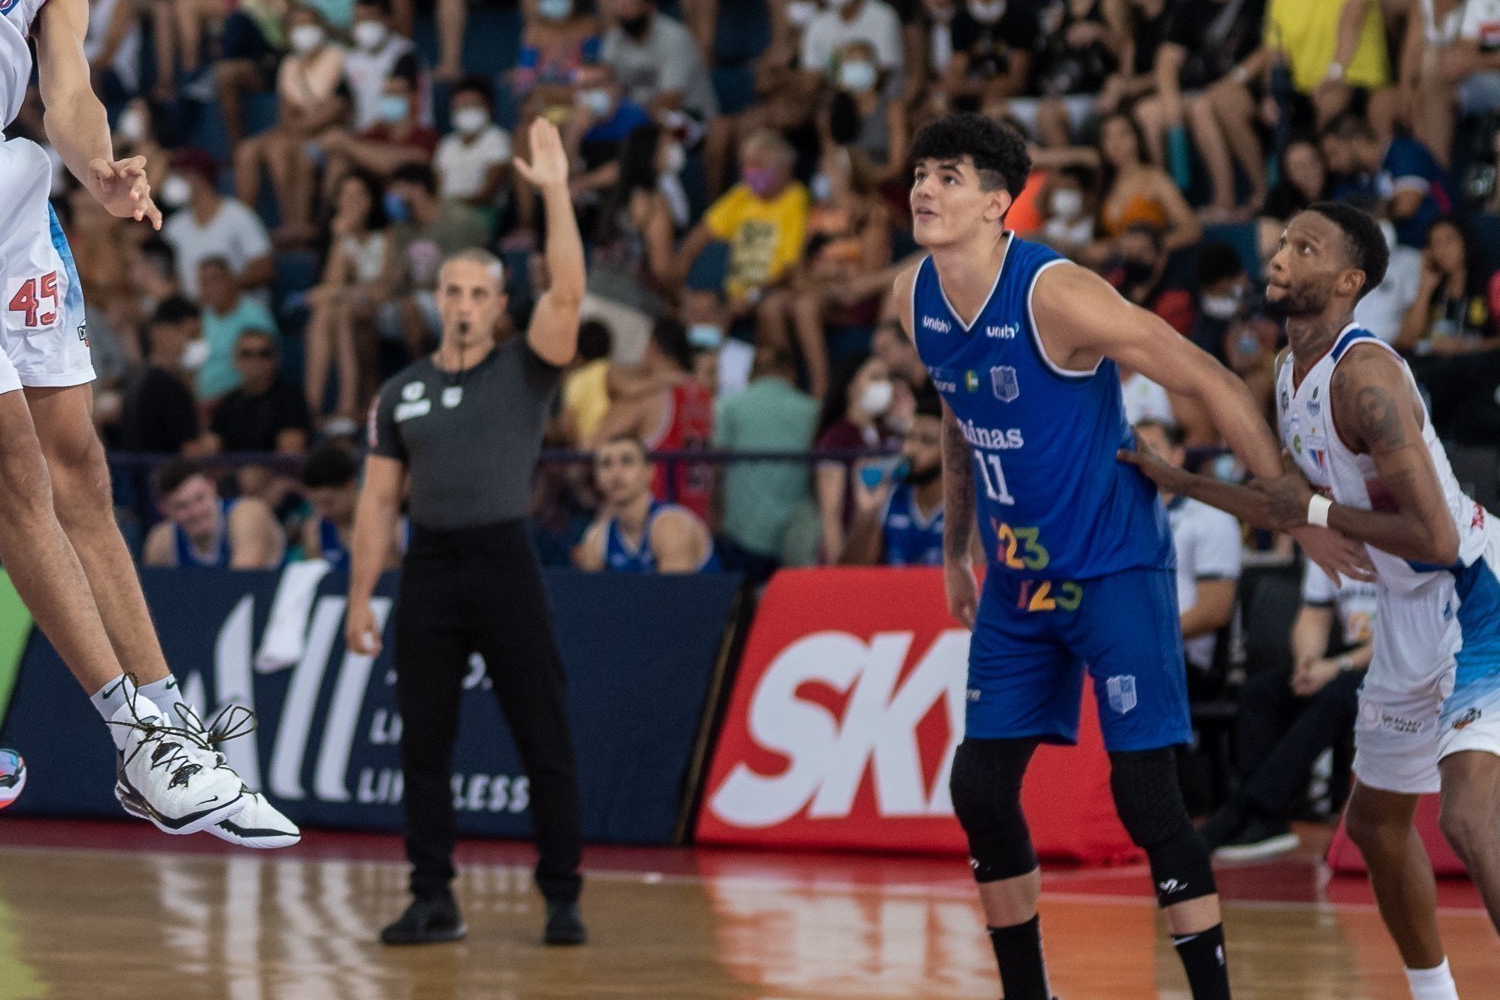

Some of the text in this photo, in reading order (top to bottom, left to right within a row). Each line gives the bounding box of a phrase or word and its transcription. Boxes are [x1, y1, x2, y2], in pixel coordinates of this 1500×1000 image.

[9, 271, 58, 328] 45
[975, 450, 1015, 506] 11
[989, 516, 1050, 571] 123
